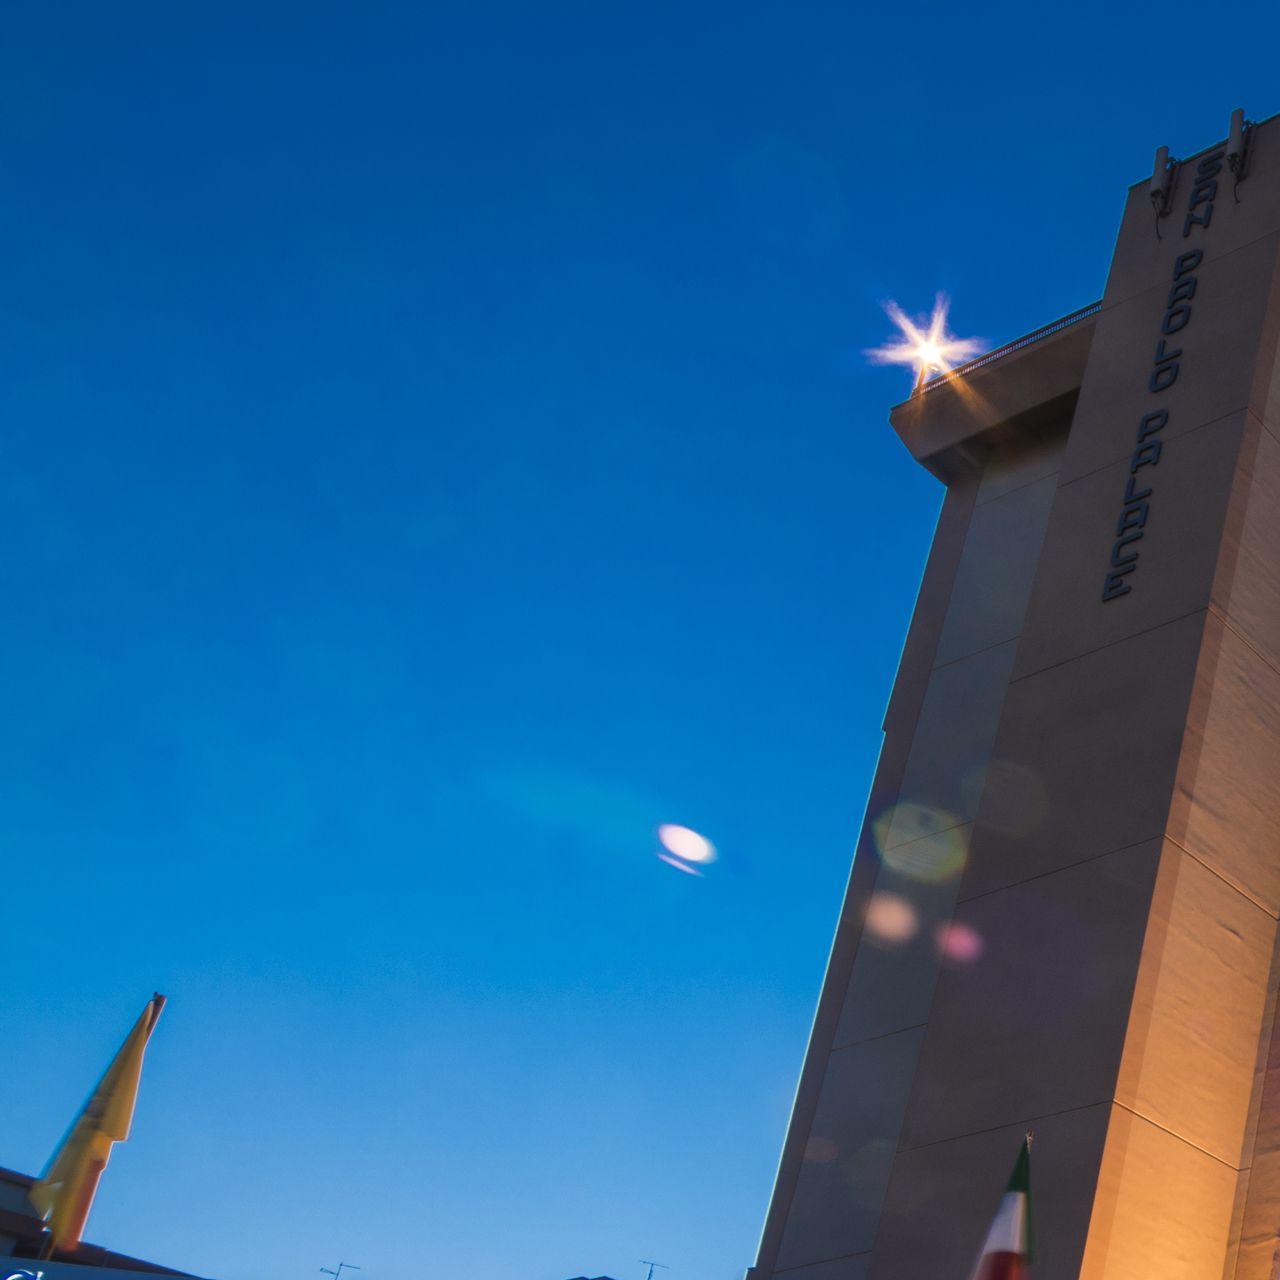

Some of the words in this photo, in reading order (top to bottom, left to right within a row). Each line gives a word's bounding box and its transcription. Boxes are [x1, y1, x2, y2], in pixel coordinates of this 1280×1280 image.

[1182, 151, 1226, 239] SAN
[1148, 248, 1204, 394] PAOLO
[1102, 408, 1170, 604] PALACE
